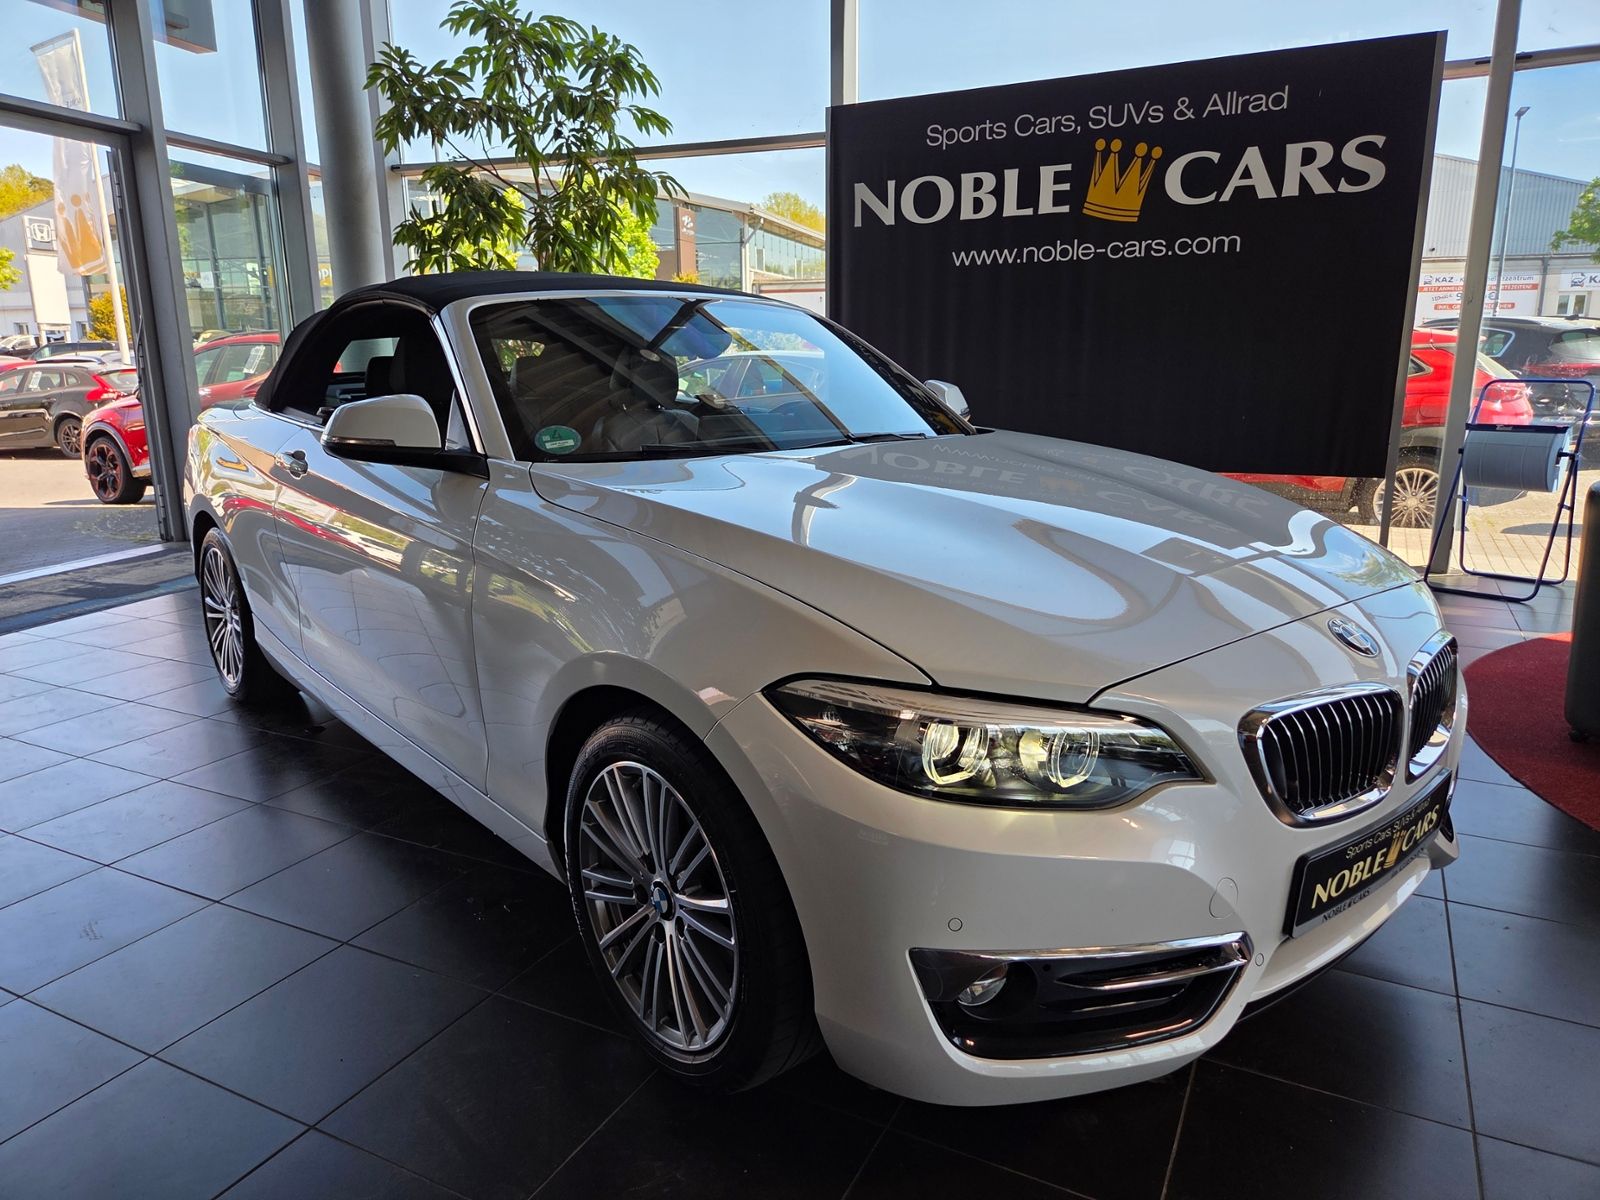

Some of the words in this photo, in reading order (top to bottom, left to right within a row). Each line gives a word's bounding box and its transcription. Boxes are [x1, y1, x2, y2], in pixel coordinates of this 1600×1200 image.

[926, 119, 1007, 151] Sports
[1014, 113, 1081, 136] Cars,
[1088, 100, 1164, 130] SUVs
[1173, 96, 1196, 121] &
[1202, 85, 1289, 118] Allrad
[853, 163, 1073, 228] NOBLE
[1164, 134, 1387, 205] CARS
[951, 235, 1241, 267] www.noble-cars.com
[1311, 848, 1387, 910] NOBLE
[1401, 804, 1440, 852] CARS
